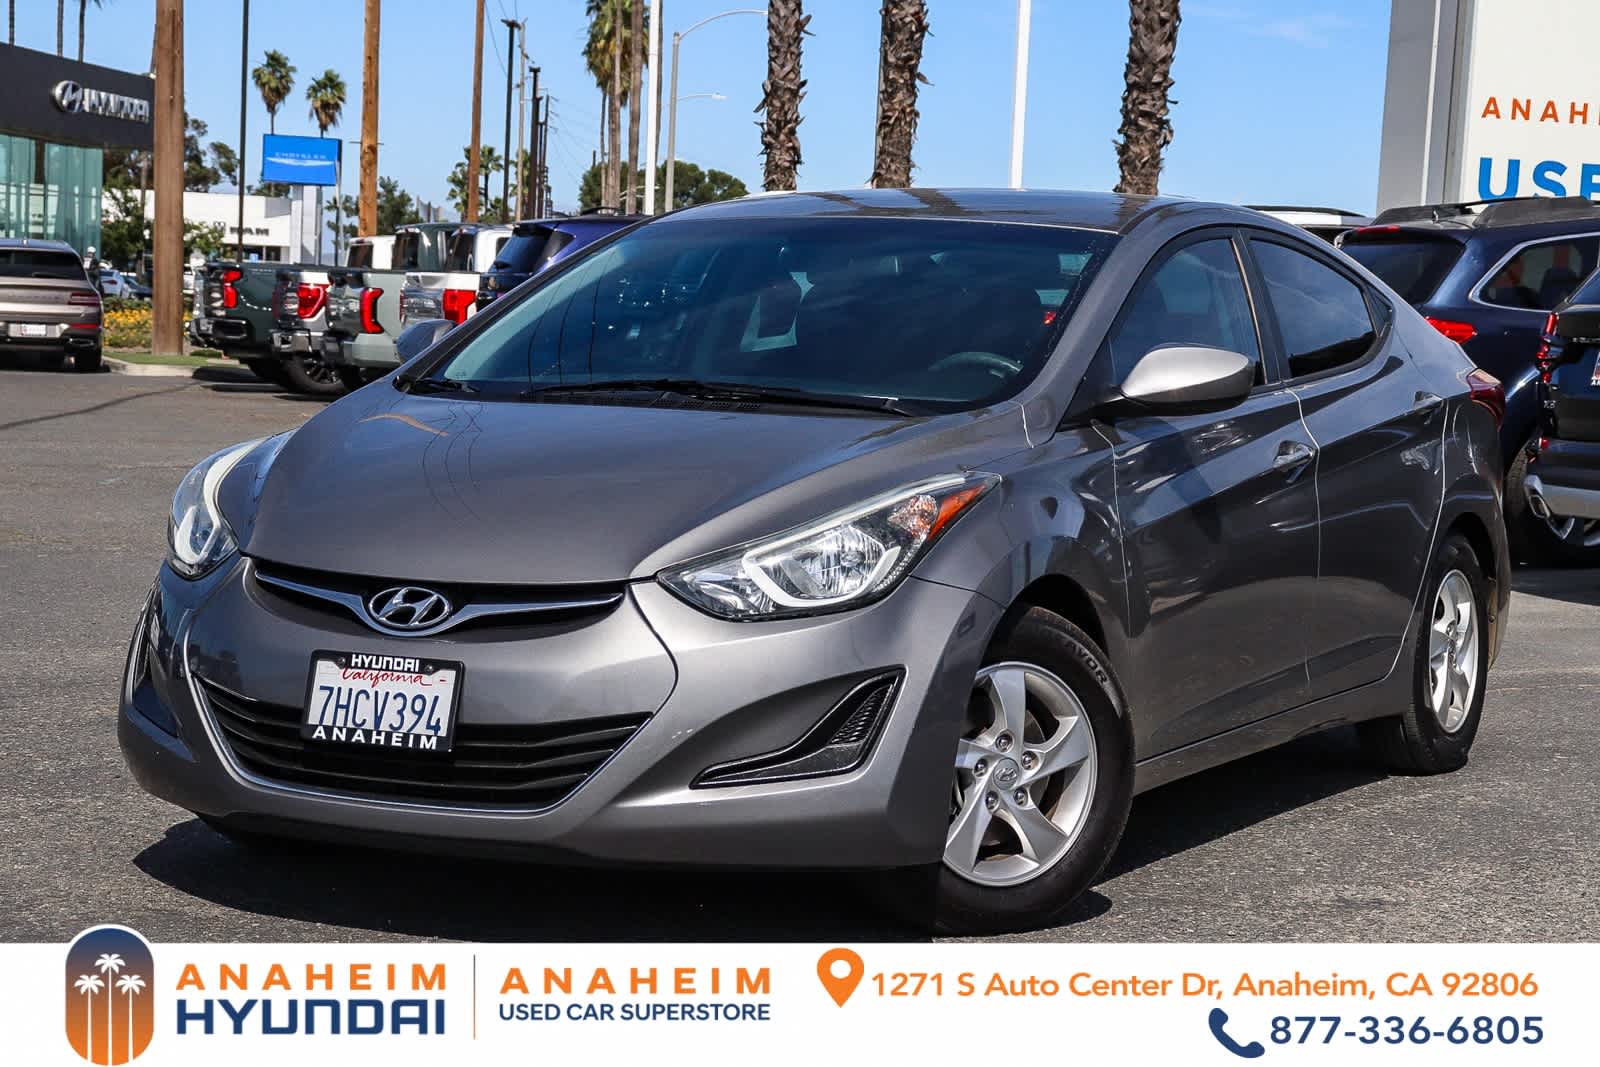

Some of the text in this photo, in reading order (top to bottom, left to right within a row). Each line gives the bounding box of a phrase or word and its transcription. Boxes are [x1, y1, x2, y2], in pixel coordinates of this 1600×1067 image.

[1481, 96, 1600, 125] ANAH
[351, 653, 420, 673] HYUNDAI
[340, 666, 433, 688] California
[318, 685, 442, 736] 7HCV394
[312, 725, 438, 750] ANAHEIM
